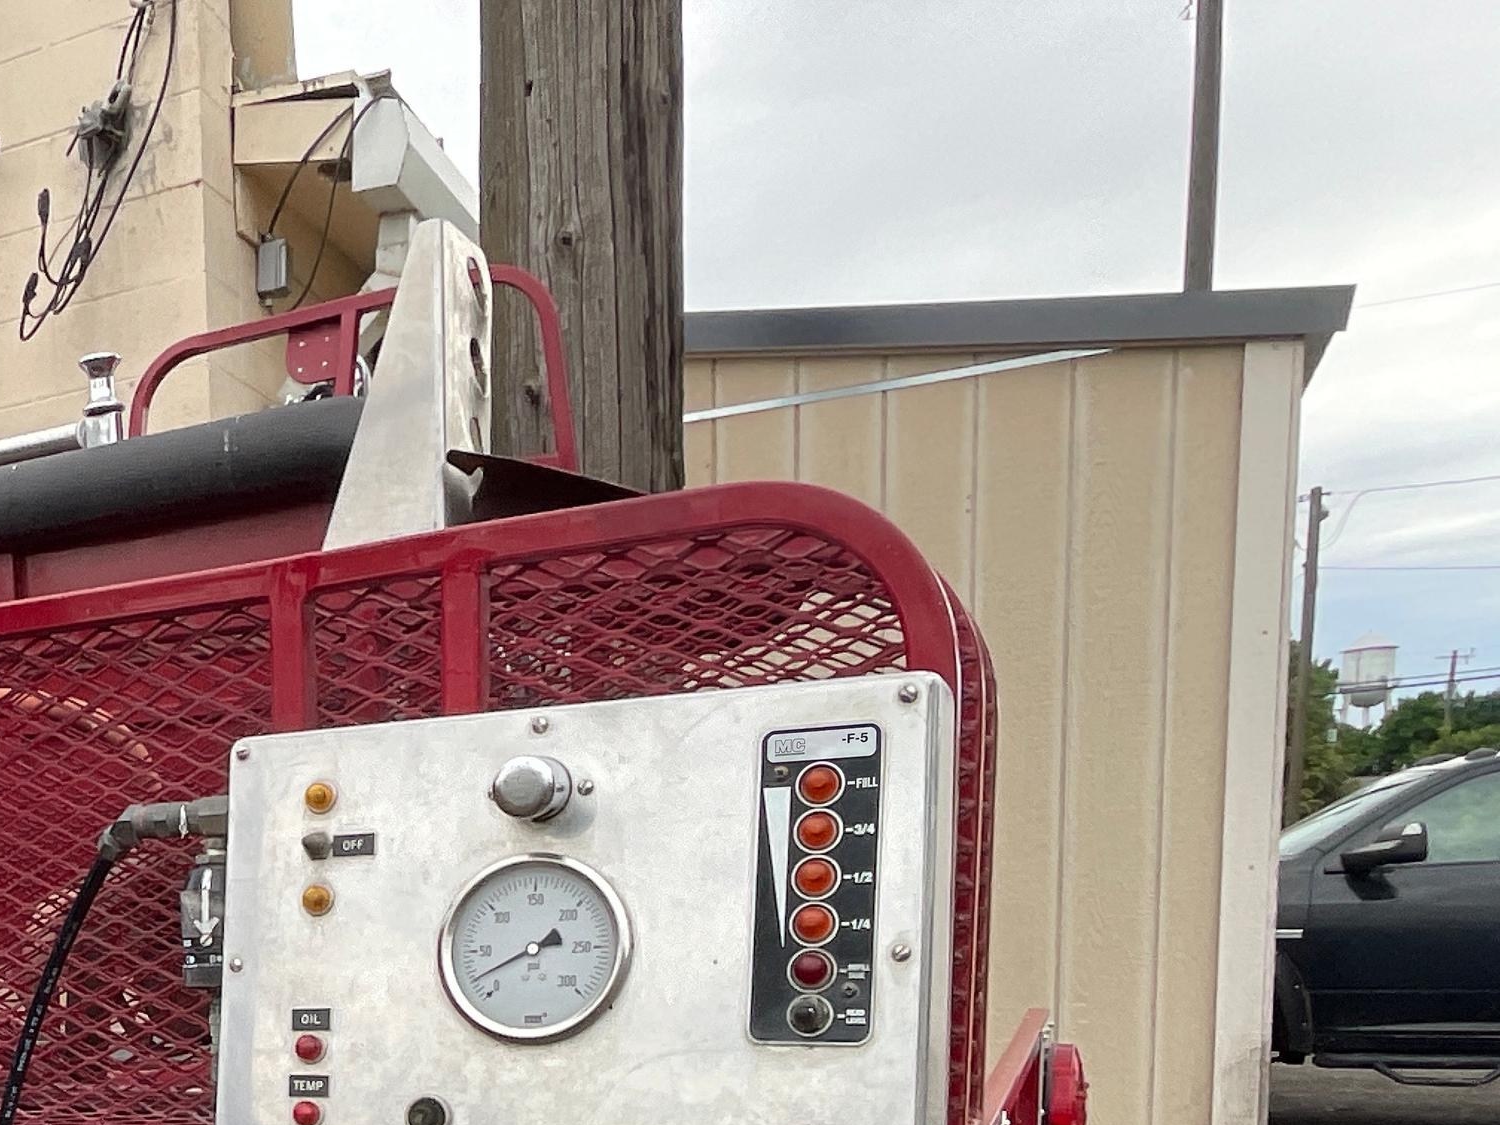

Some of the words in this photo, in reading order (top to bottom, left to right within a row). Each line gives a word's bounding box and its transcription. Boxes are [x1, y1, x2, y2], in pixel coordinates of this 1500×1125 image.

[775, 738, 806, 754] MC
[342, 838, 364, 851] OFF
[527, 893, 544, 906] 150
[494, 911, 510, 924] 100
[558, 908, 578, 922] 200
[479, 945, 492, 957] 50
[571, 941, 591, 954] 250
[493, 979, 500, 991] 0
[557, 975, 577, 987] 300
[301, 1014, 321, 1025] OIL
[293, 1080, 324, 1091] TEMP
